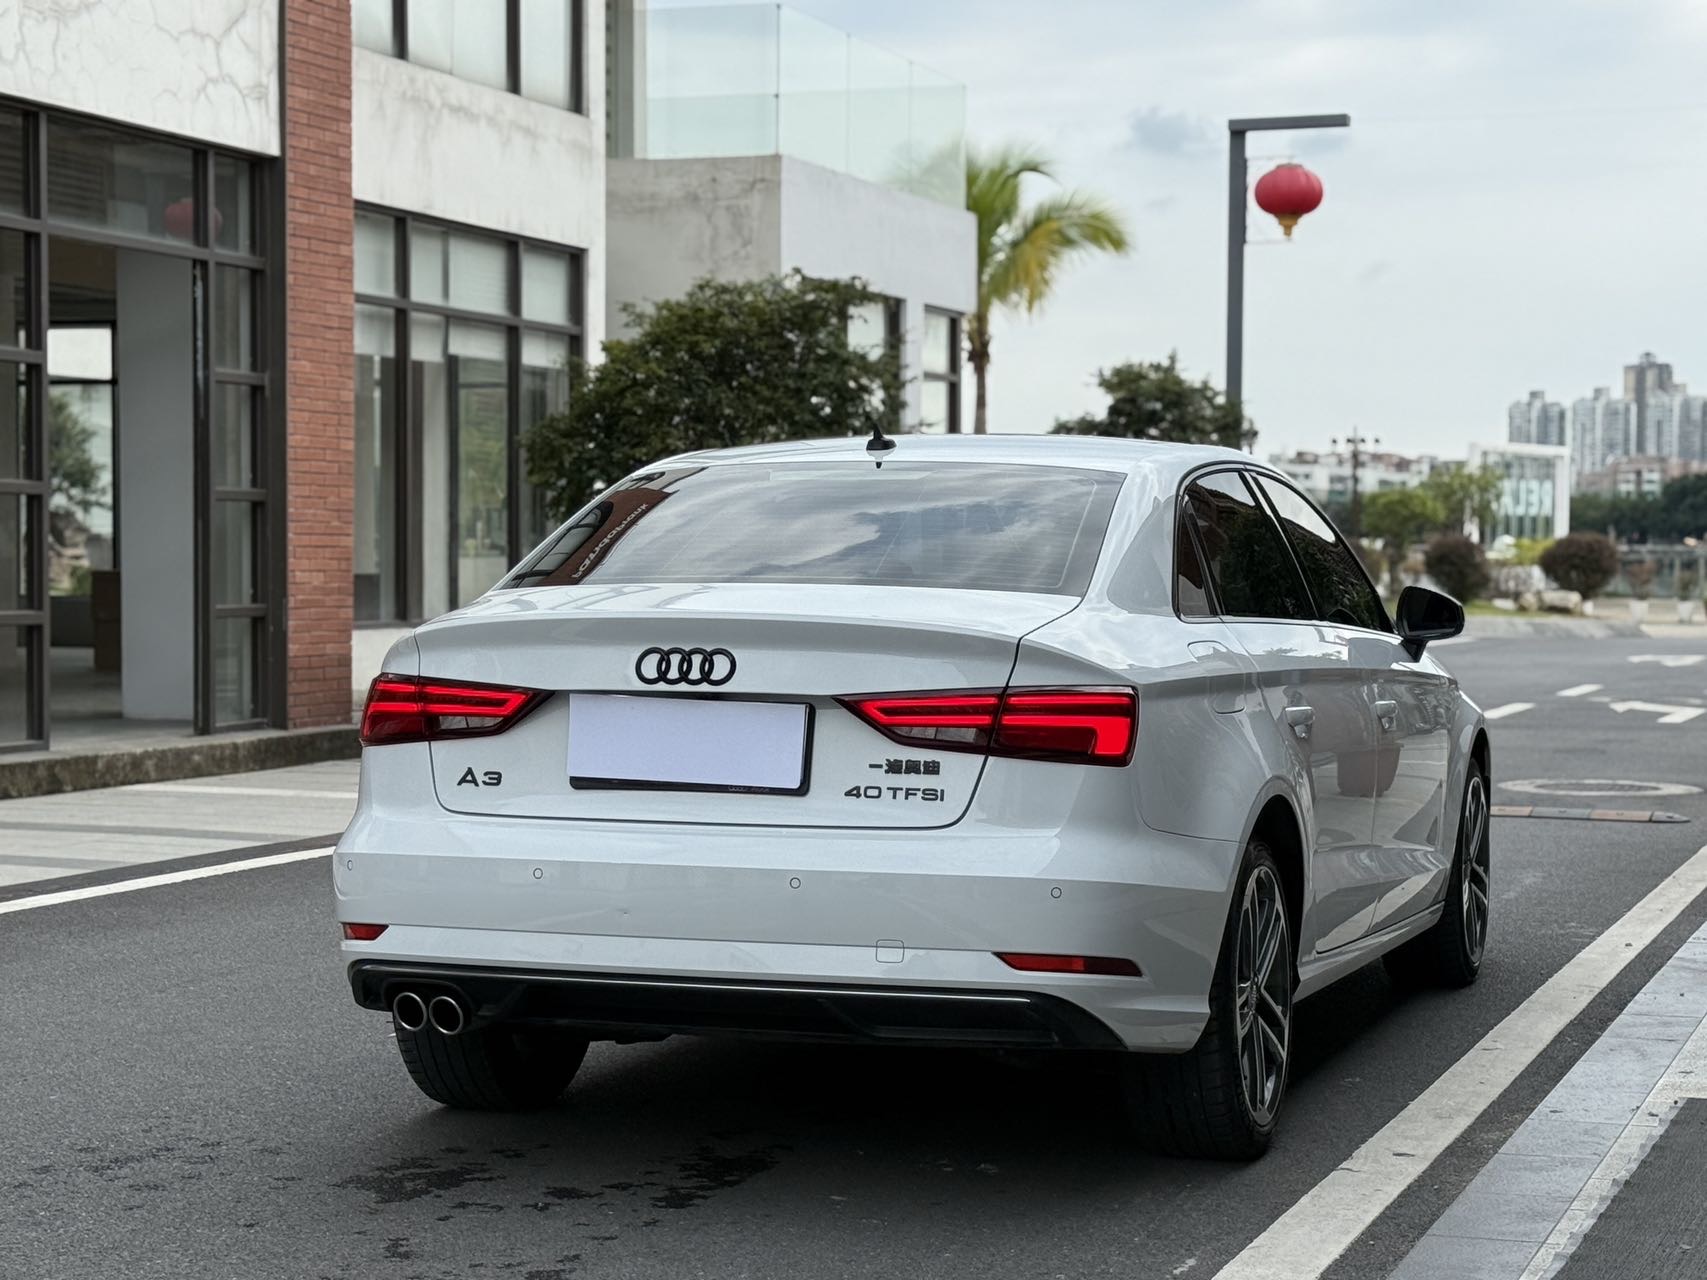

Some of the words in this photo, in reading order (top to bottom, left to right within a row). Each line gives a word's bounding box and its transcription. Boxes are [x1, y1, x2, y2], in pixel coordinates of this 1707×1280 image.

[456, 766, 503, 788] A3
[843, 785, 882, 799] 40
[886, 787, 945, 802] TFSI
